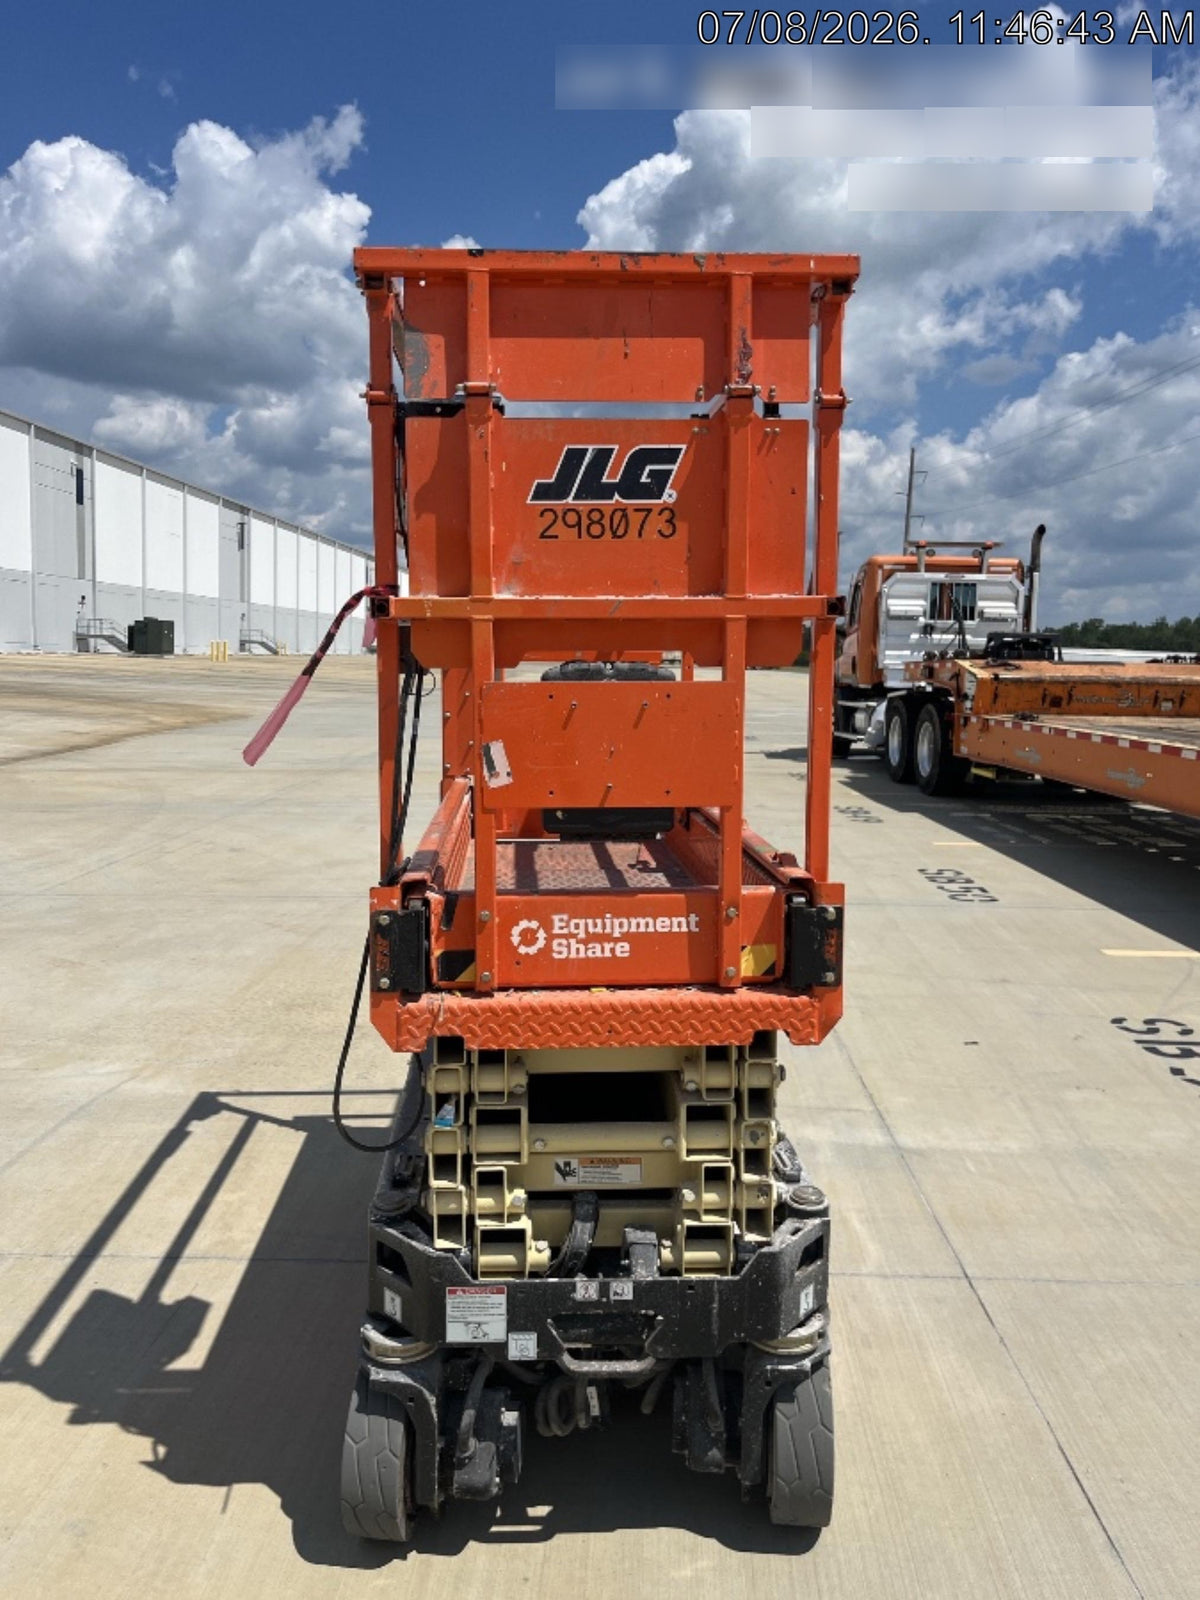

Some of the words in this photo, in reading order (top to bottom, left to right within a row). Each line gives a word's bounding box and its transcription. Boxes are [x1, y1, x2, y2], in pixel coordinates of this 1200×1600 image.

[538, 507, 677, 540] 298073
[551, 913, 700, 938] Equipment
[551, 938, 631, 959] Share
